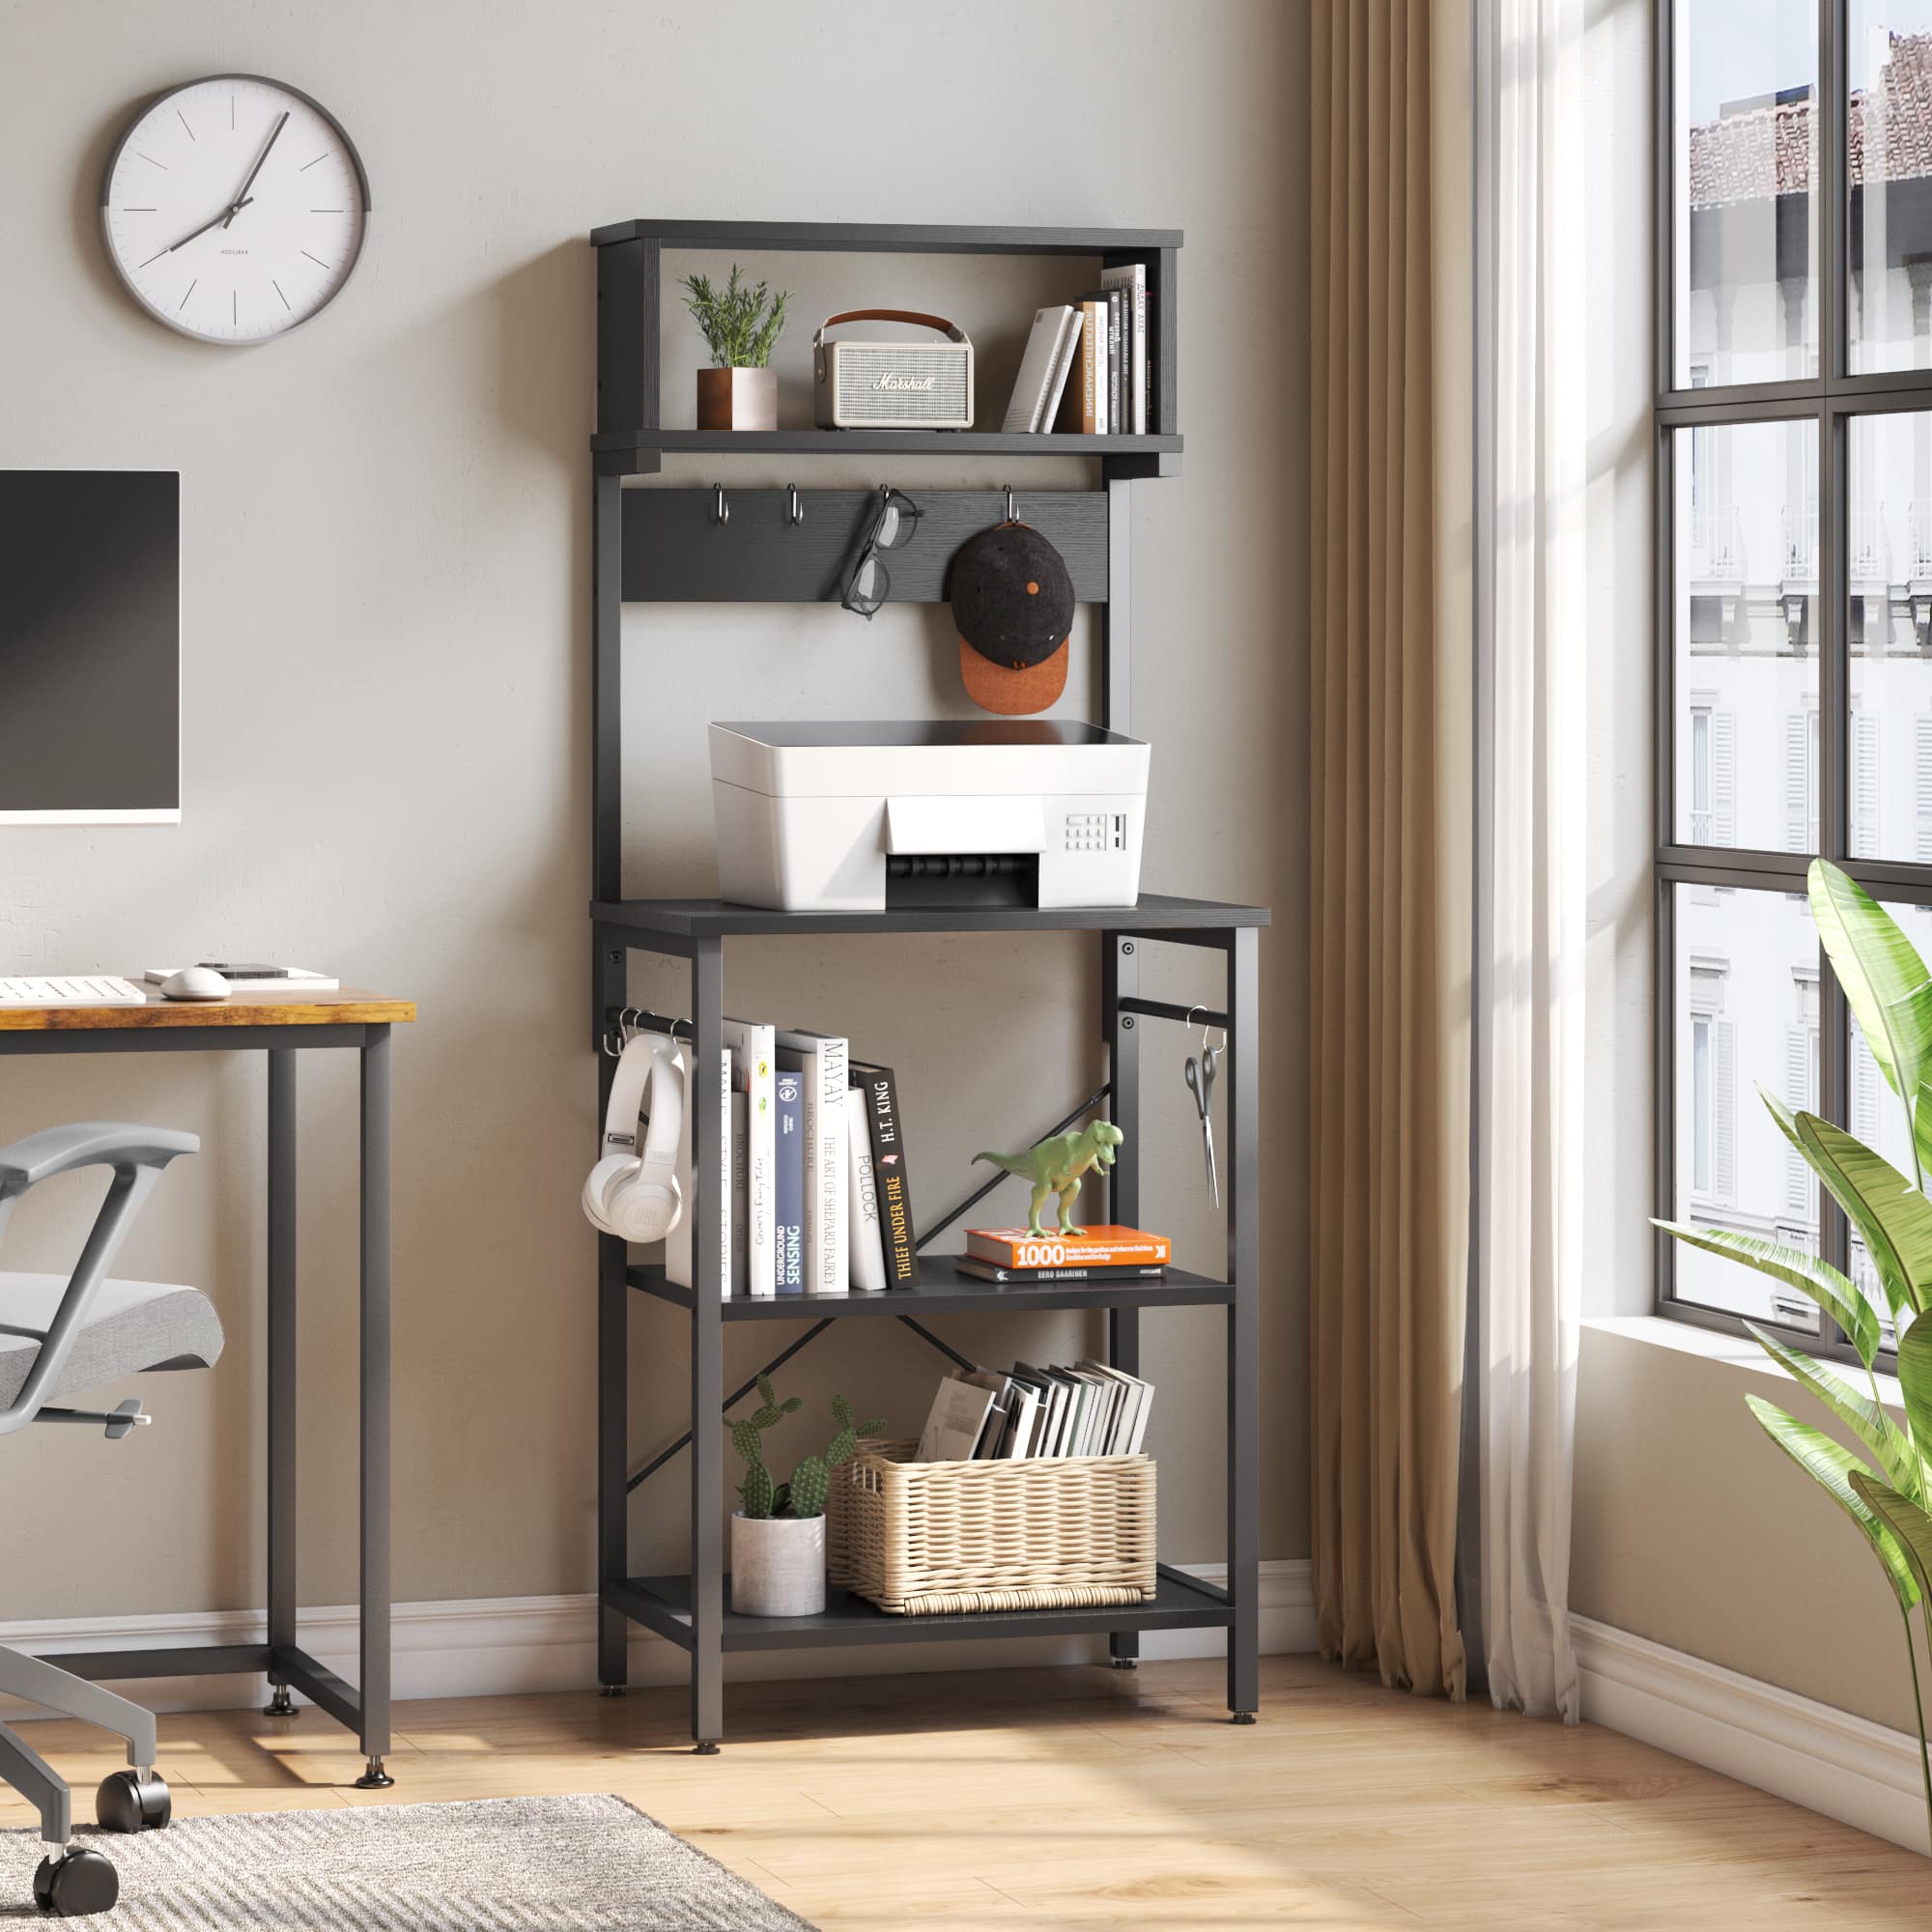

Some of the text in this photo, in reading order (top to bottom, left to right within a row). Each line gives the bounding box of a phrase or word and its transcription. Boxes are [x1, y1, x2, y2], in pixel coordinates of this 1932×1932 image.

[873, 372, 936, 390] Marshall
[824, 1042, 842, 1107] MAYAY
[806, 1102, 814, 1173] BROCHURE
[875, 1081, 894, 1144] H.T. KING
[824, 1137, 836, 1156] THE
[824, 1158, 836, 1179] ART
[824, 1181, 836, 1197] OF
[857, 1155, 877, 1222] POLLOCK
[824, 1198, 836, 1246] SHEPARD
[887, 1176, 911, 1280] THIEF UNDER FIRE
[777, 1226, 785, 1286] UNDERGROUND
[786, 1225, 800, 1285] SENSING
[1017, 1245, 1065, 1265] 1000
[1037, 1269, 1088, 1279] EERO SAARINEN
